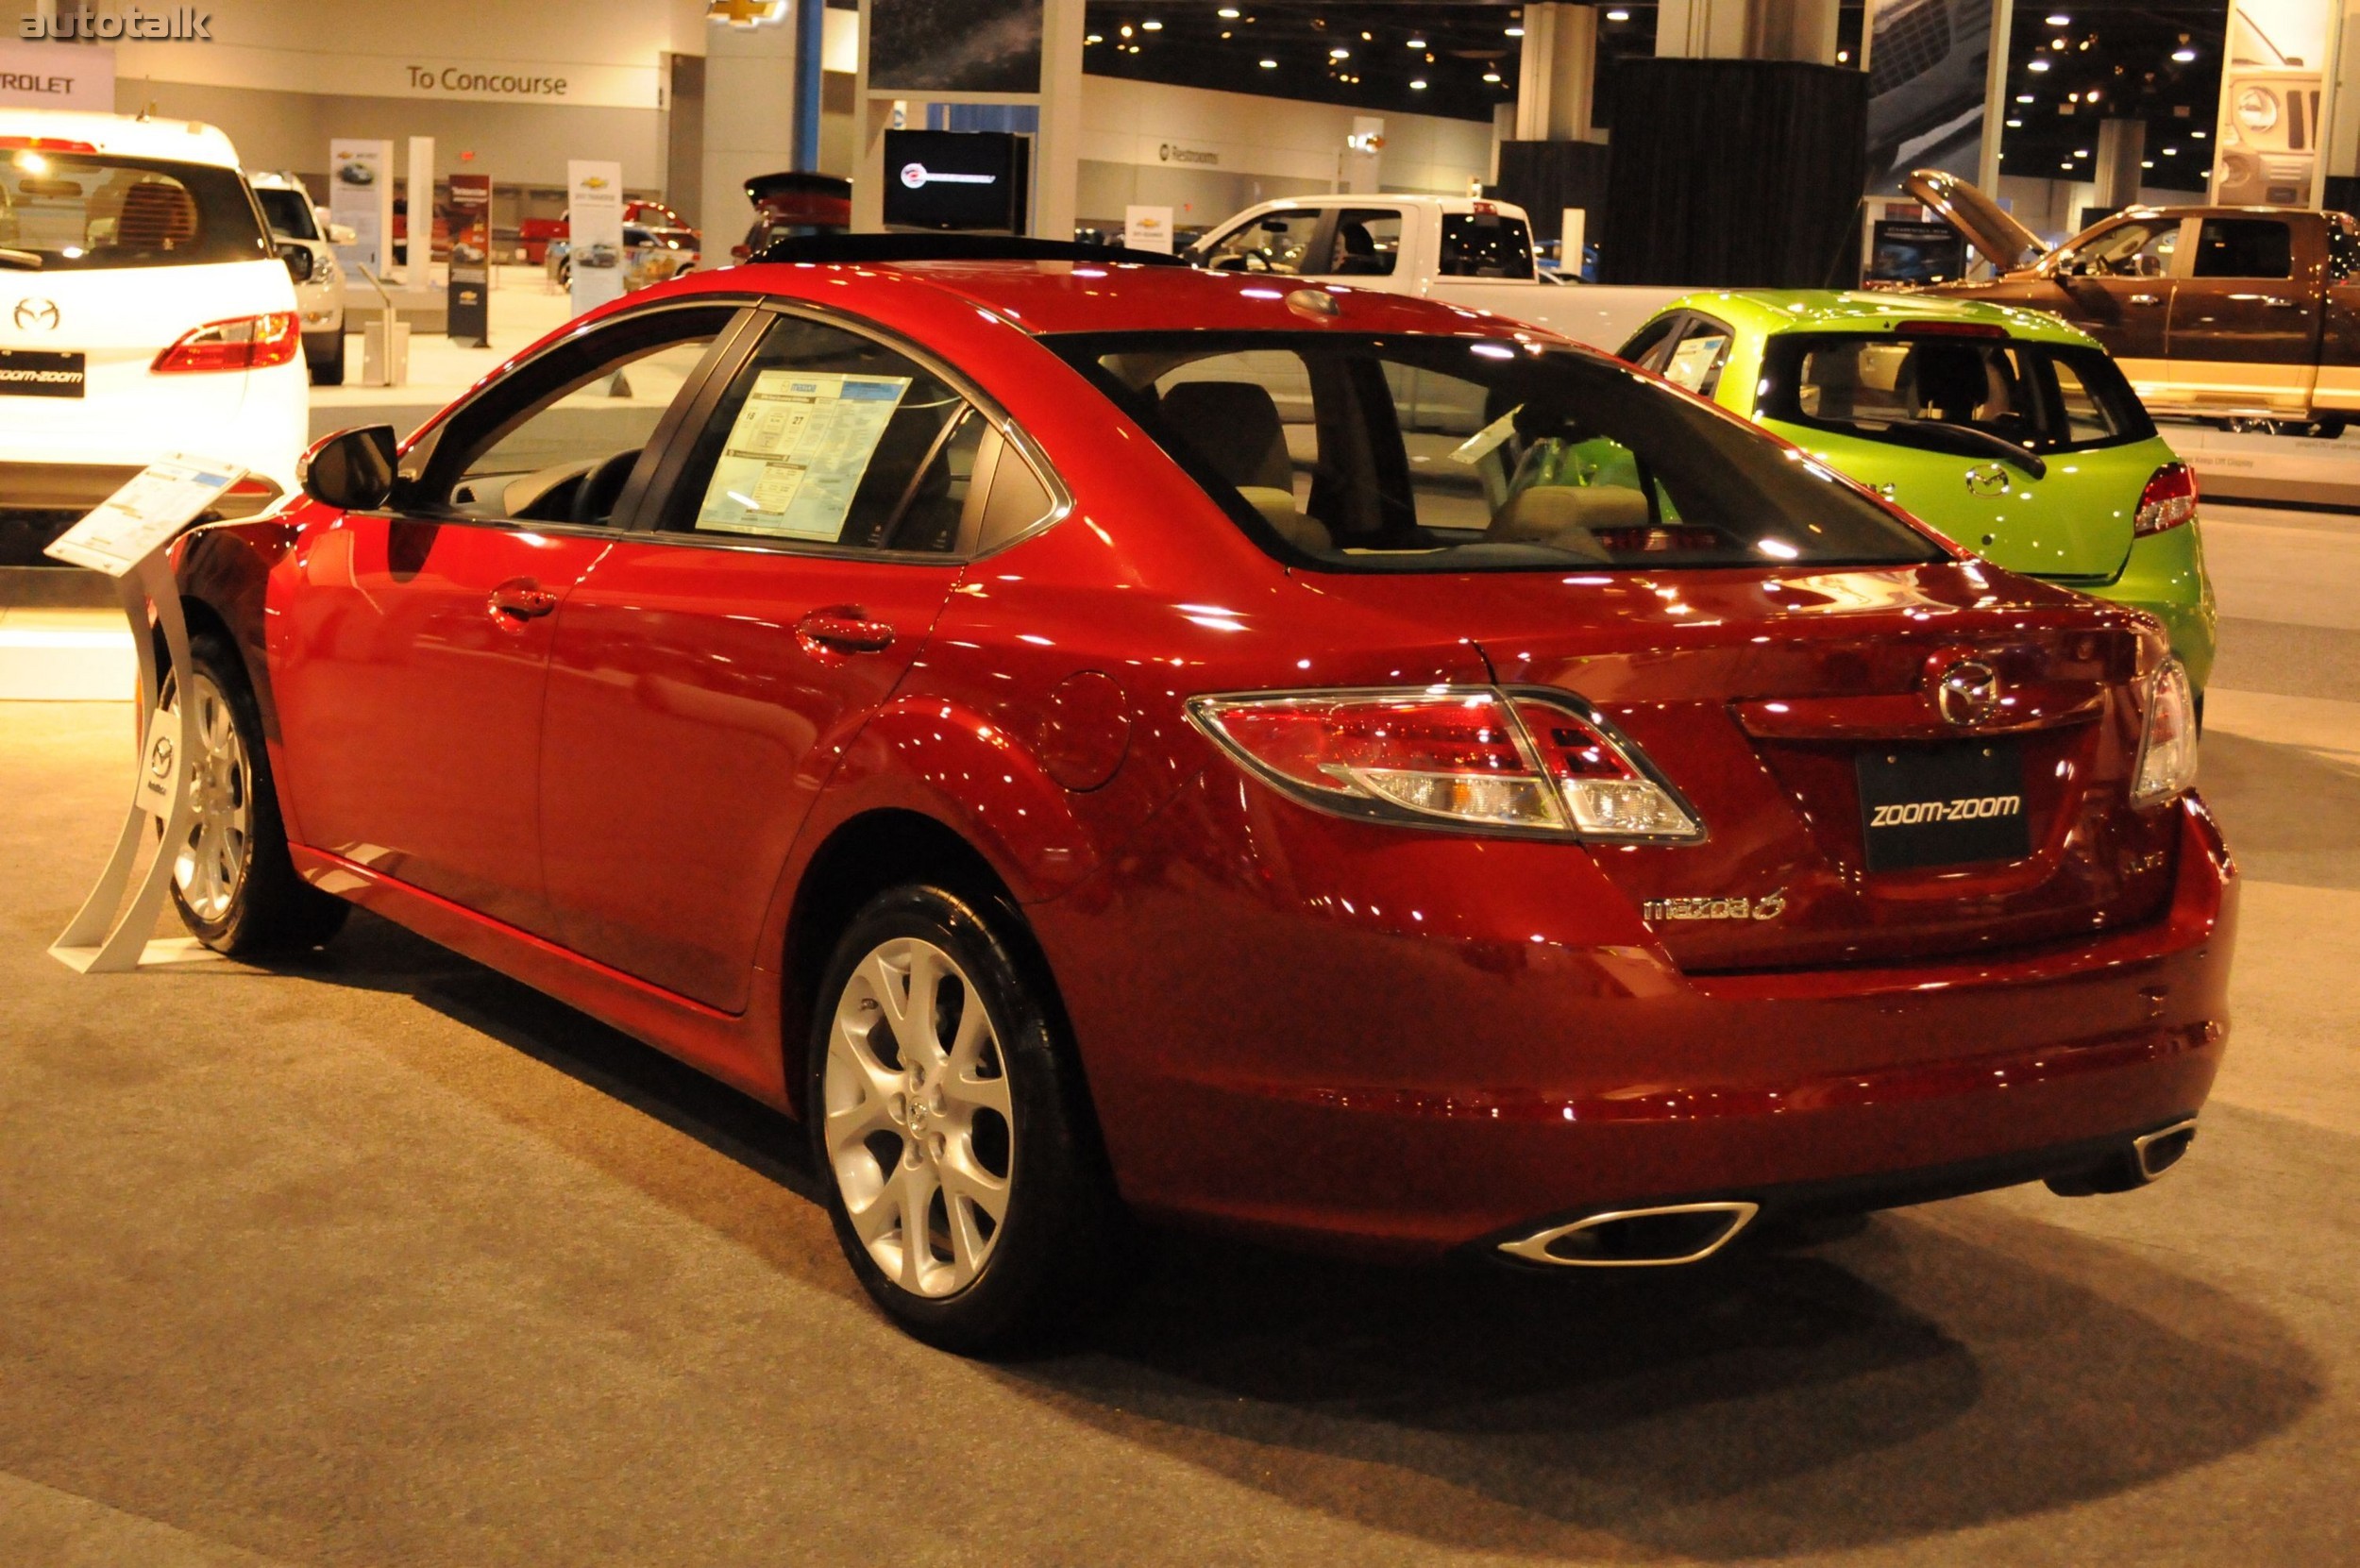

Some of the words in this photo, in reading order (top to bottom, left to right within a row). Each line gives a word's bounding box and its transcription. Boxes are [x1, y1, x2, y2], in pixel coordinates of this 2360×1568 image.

[0, 73, 75, 94] ROLET
[407, 65, 434, 90] To
[441, 67, 567, 95] Concourse
[0, 369, 83, 383] oom-zoom
[1870, 795, 2020, 827] zoom-zoom
